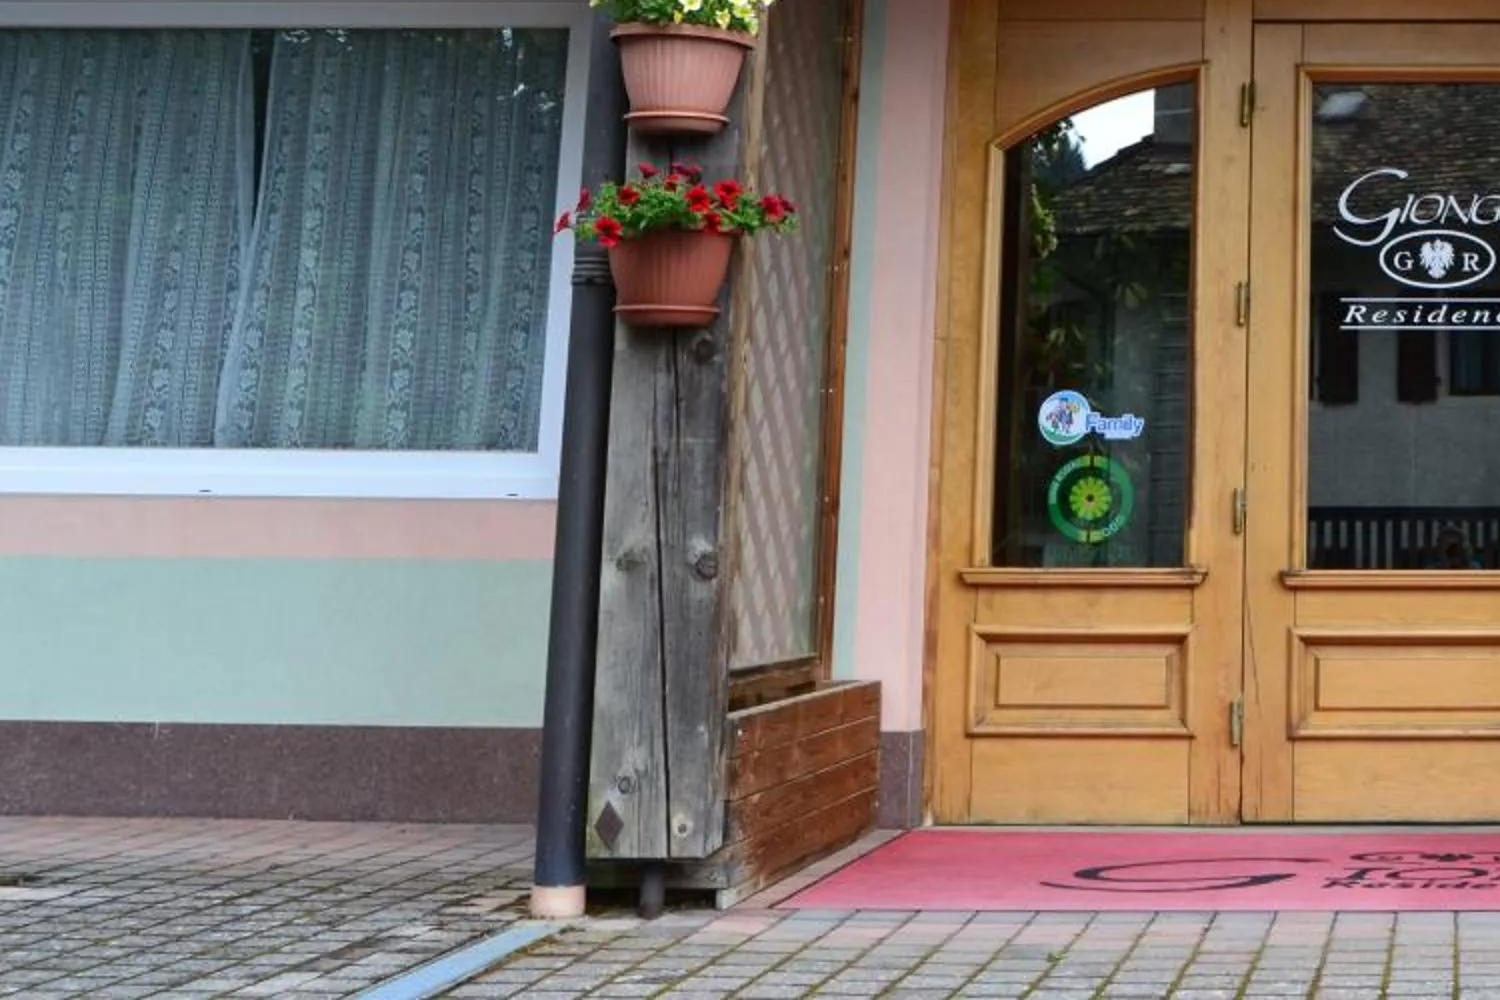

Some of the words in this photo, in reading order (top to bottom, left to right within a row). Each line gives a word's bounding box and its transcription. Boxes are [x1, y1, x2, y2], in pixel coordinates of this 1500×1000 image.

[1393, 252, 1414, 271] G
[1462, 252, 1481, 271] R
[1086, 413, 1144, 435] Family
